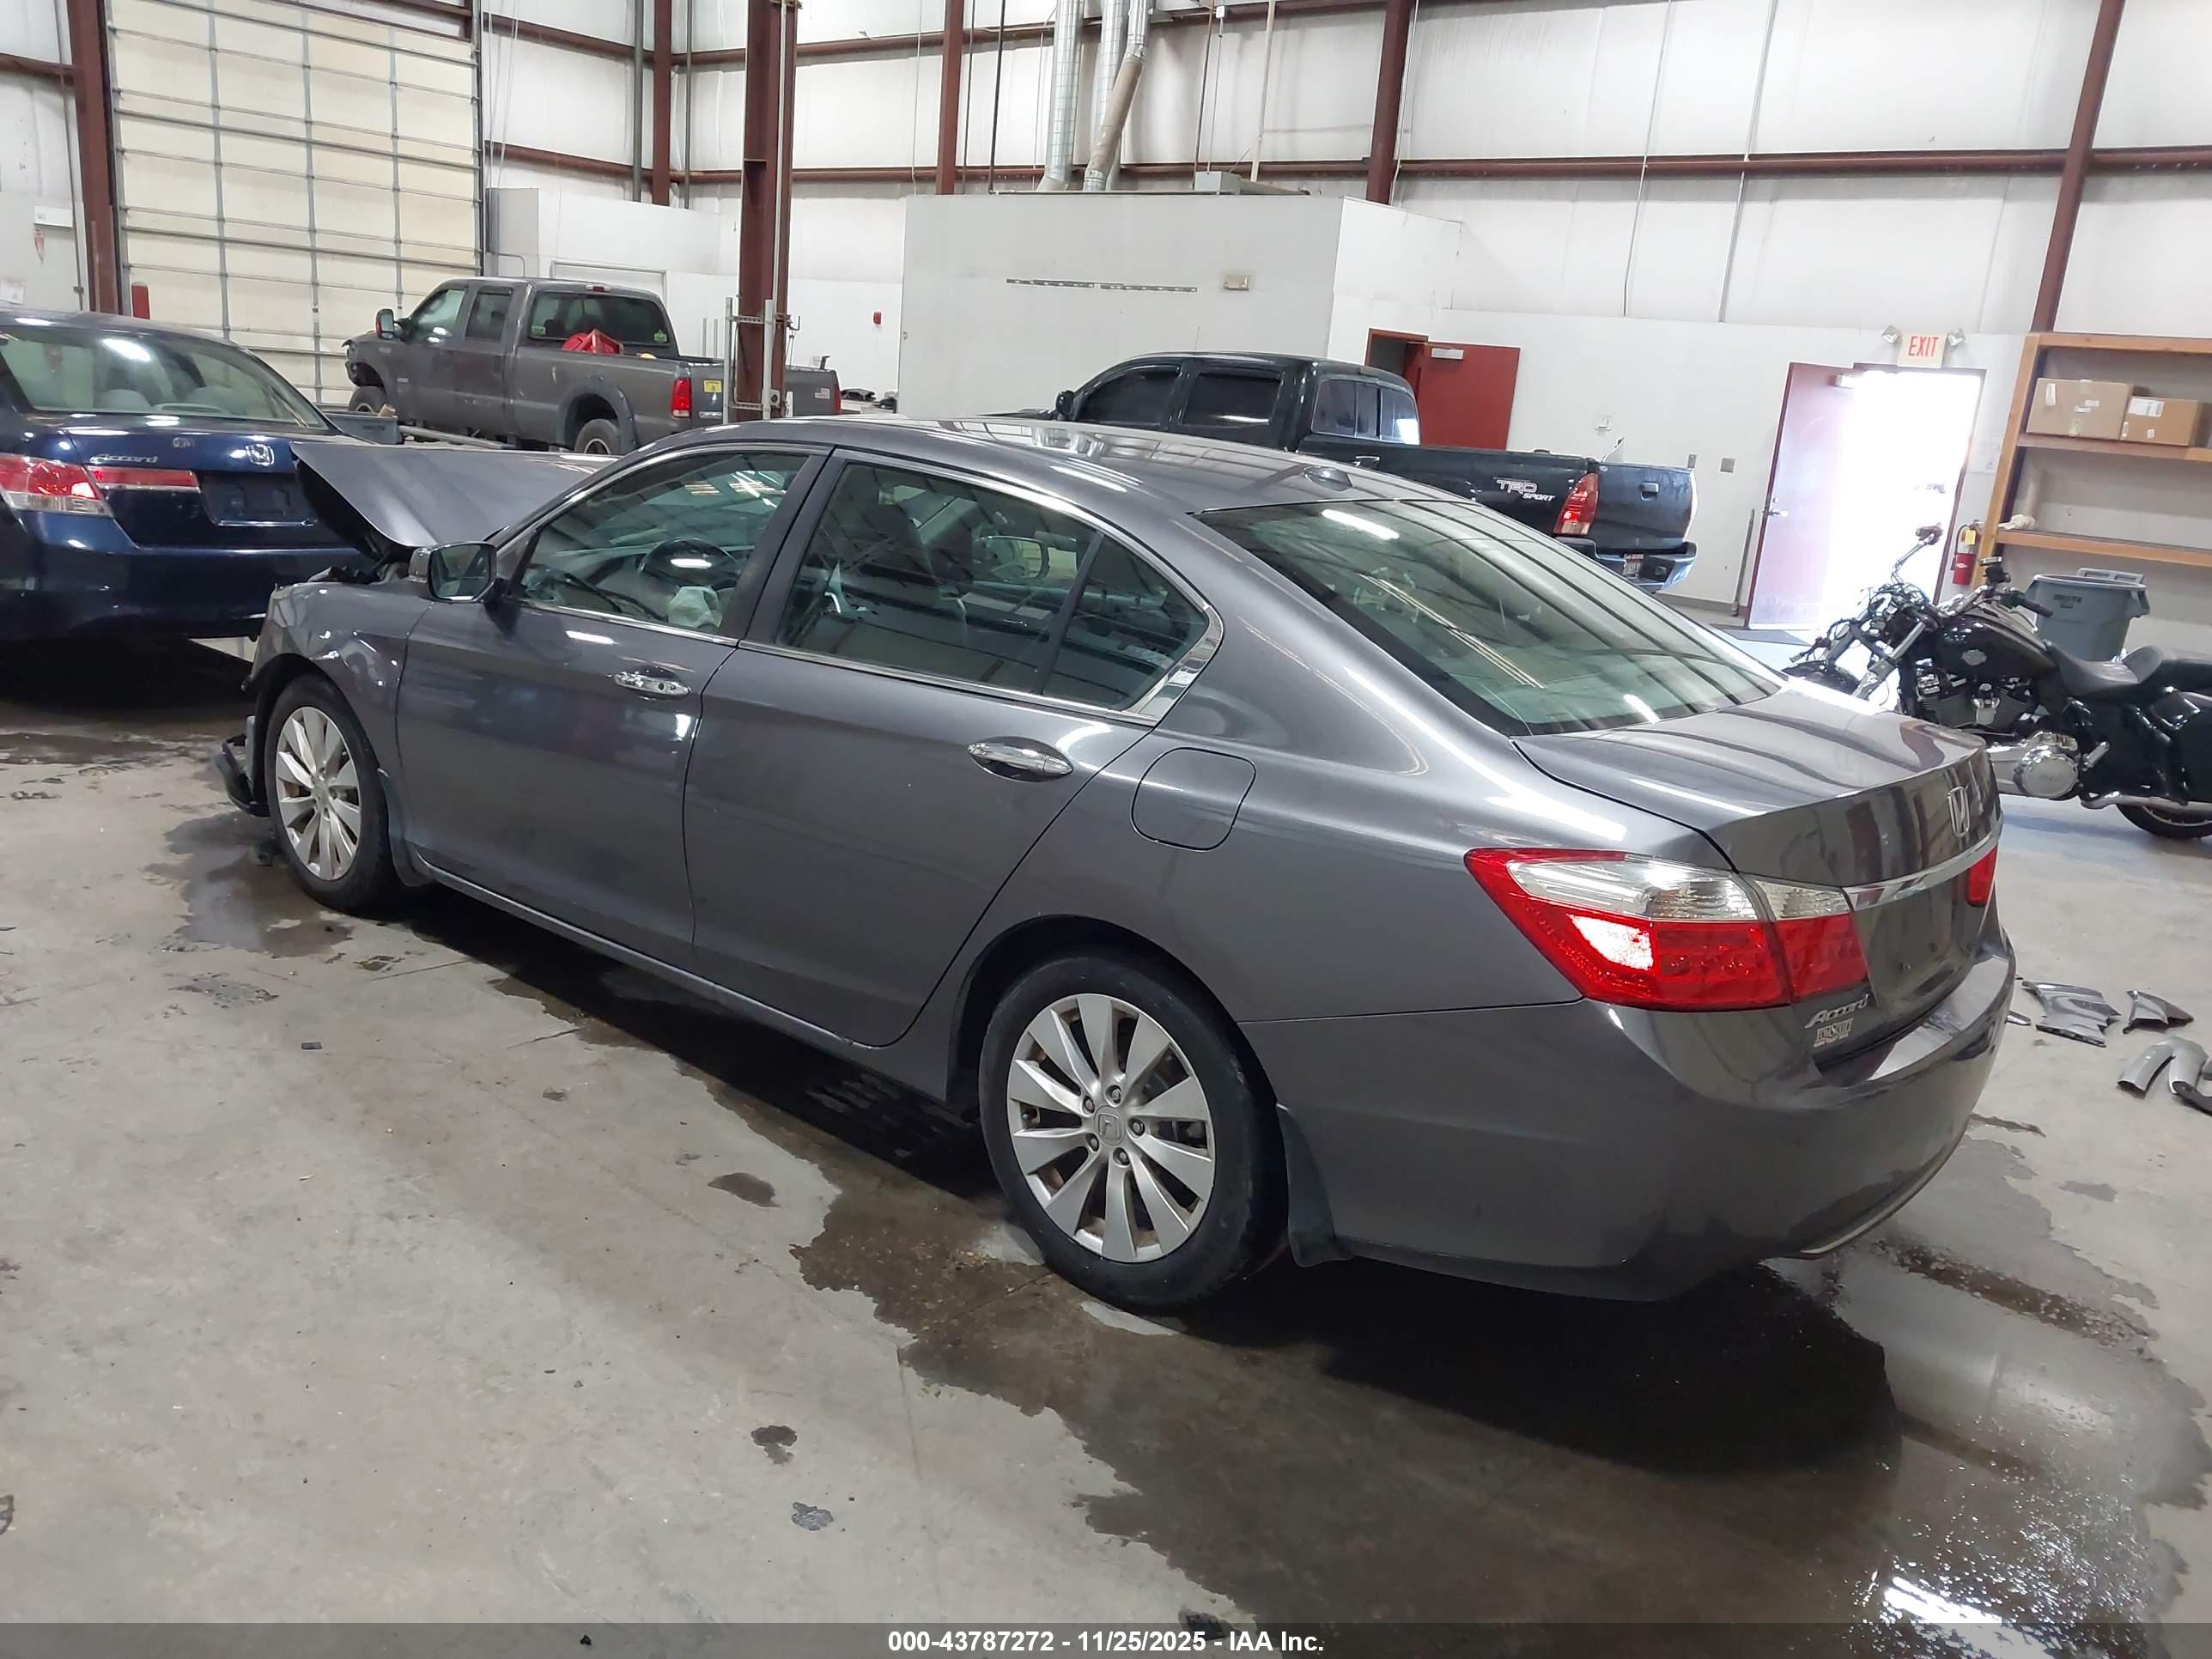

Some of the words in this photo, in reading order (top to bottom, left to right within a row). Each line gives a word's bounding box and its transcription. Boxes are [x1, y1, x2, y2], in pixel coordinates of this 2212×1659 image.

[1907, 336, 1940, 357] EXIT
[89, 453, 158, 465] Accord
[1522, 492, 1556, 501] SPORT
[1804, 994, 1869, 1029] Accord
